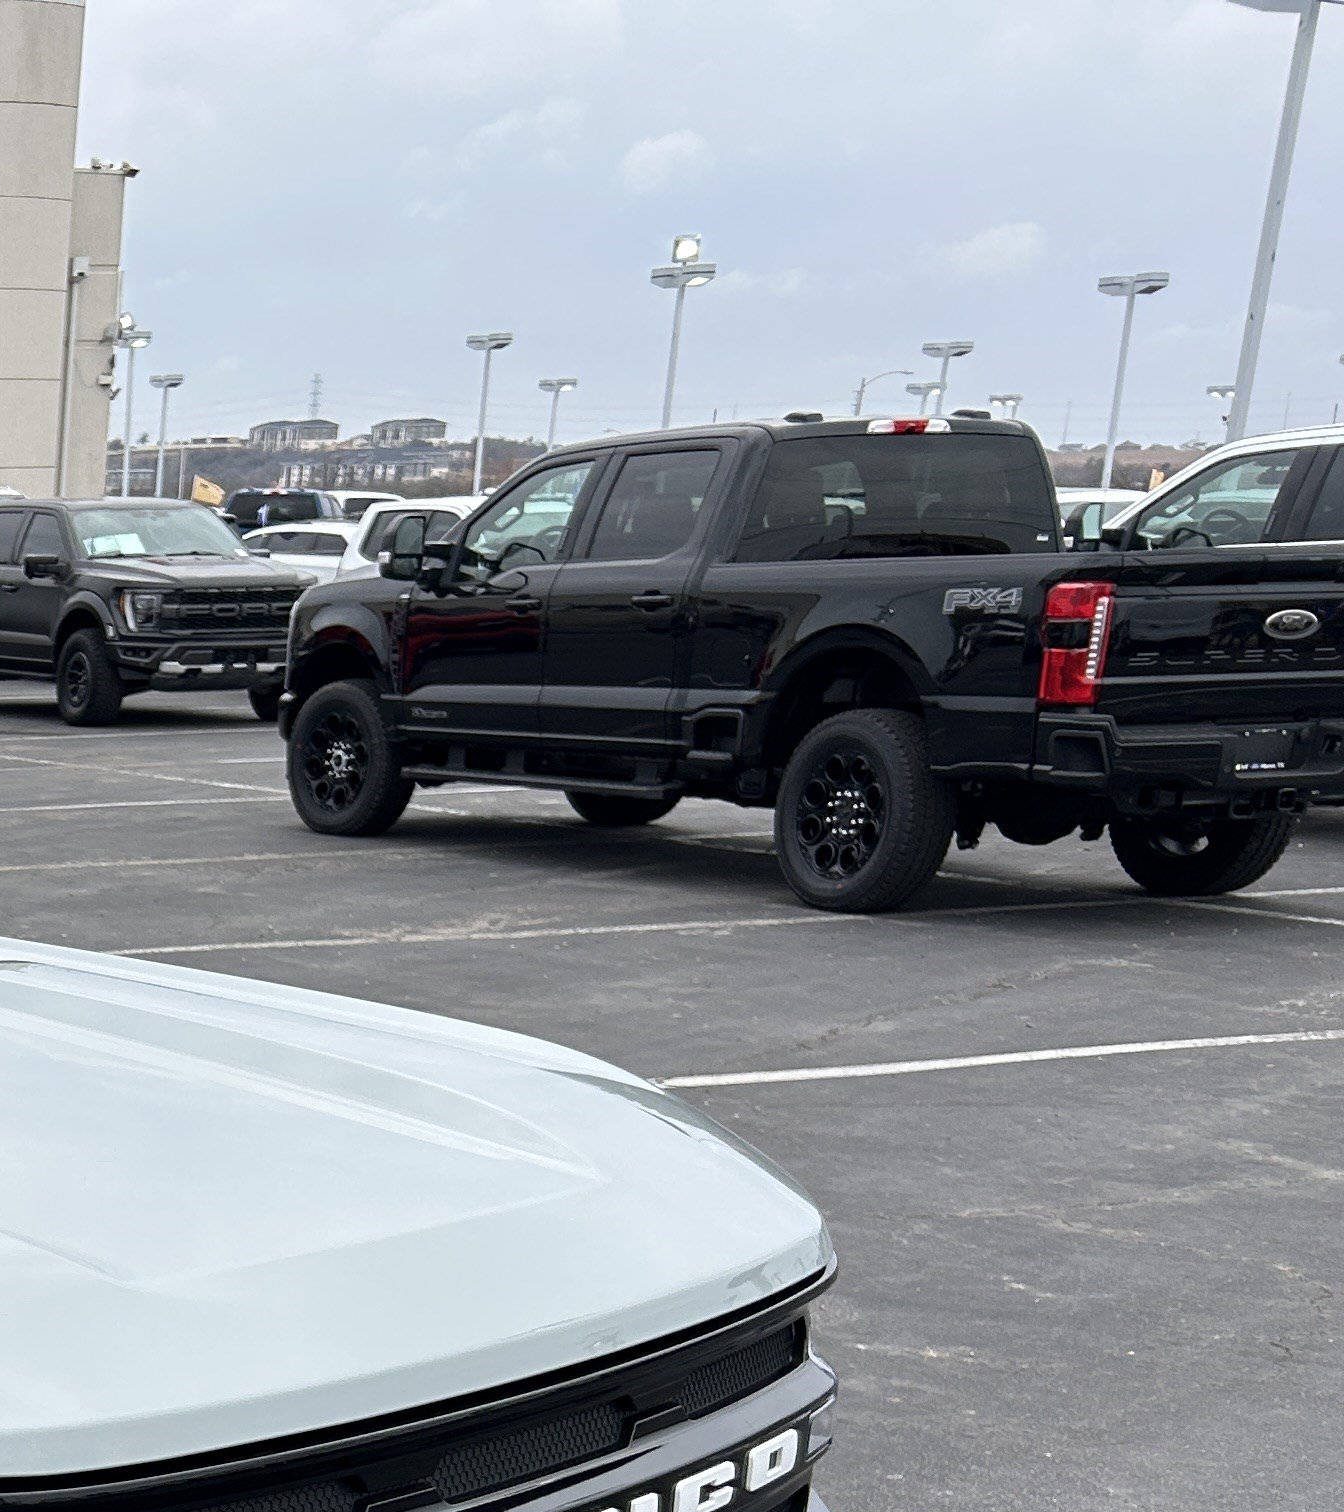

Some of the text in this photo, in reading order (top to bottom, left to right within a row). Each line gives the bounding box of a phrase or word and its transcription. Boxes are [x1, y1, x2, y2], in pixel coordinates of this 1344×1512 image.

[942, 587, 1023, 615] FX4
[181, 603, 292, 619] FORD
[1127, 648, 1300, 667] SUPER
